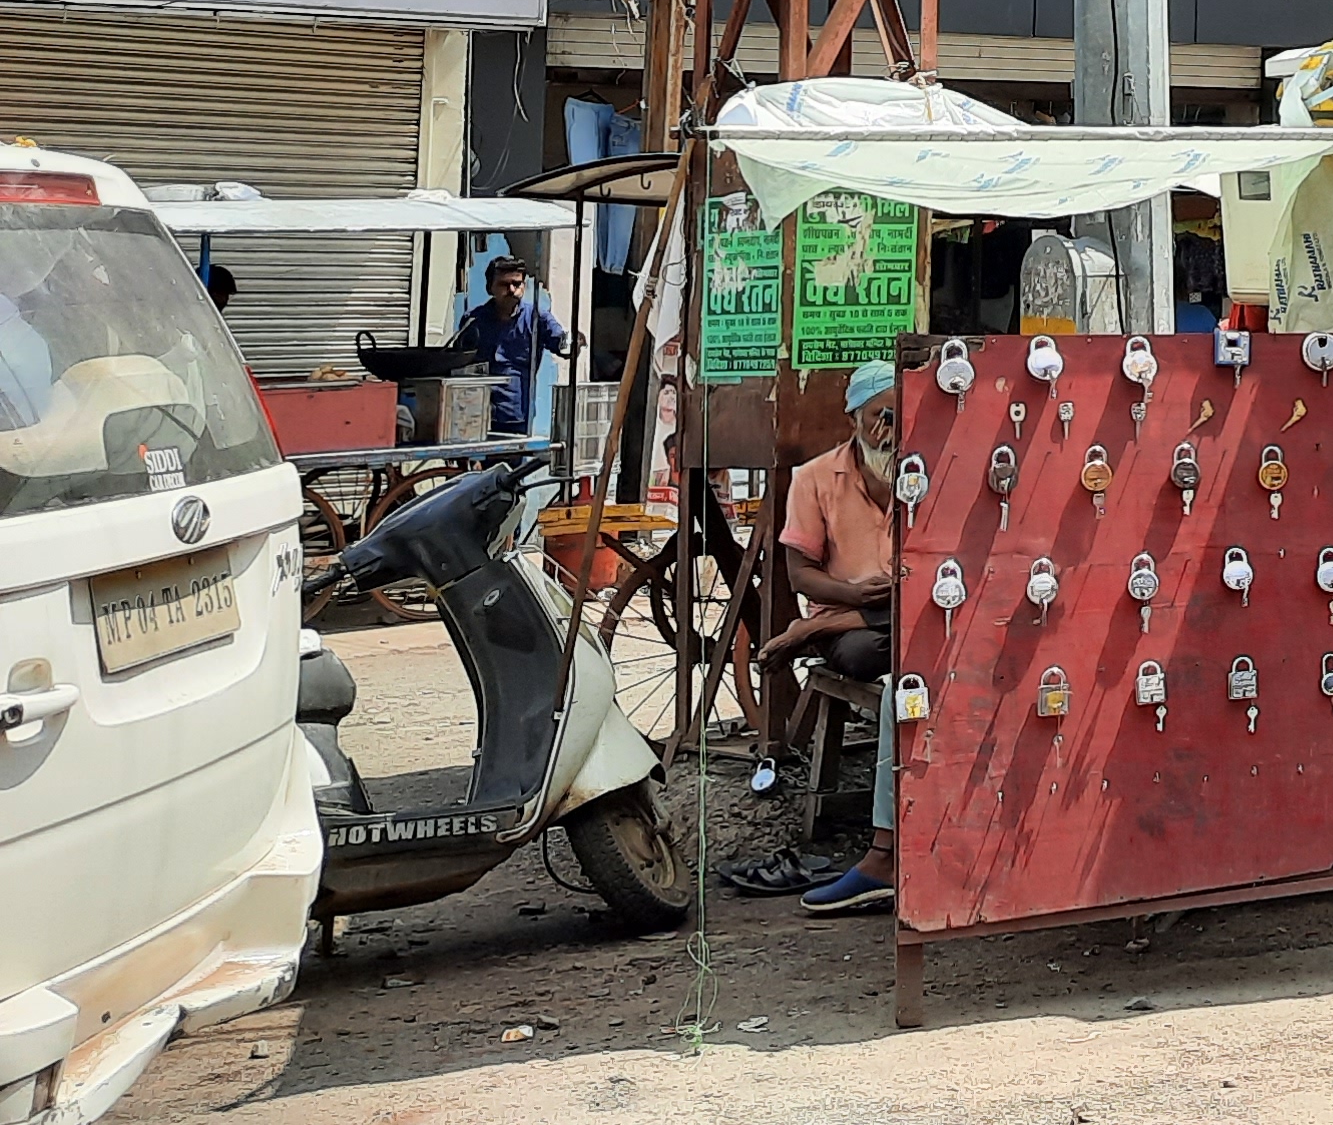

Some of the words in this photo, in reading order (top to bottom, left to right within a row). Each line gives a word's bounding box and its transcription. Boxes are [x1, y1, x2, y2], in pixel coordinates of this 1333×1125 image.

[1302, 233, 1327, 291] RATNAMANI
[855, 274, 912, 305] रतन
[144, 448, 183, 474] SIDDI
[161, 586, 187, 625] TA
[190, 571, 234, 618] 2315
